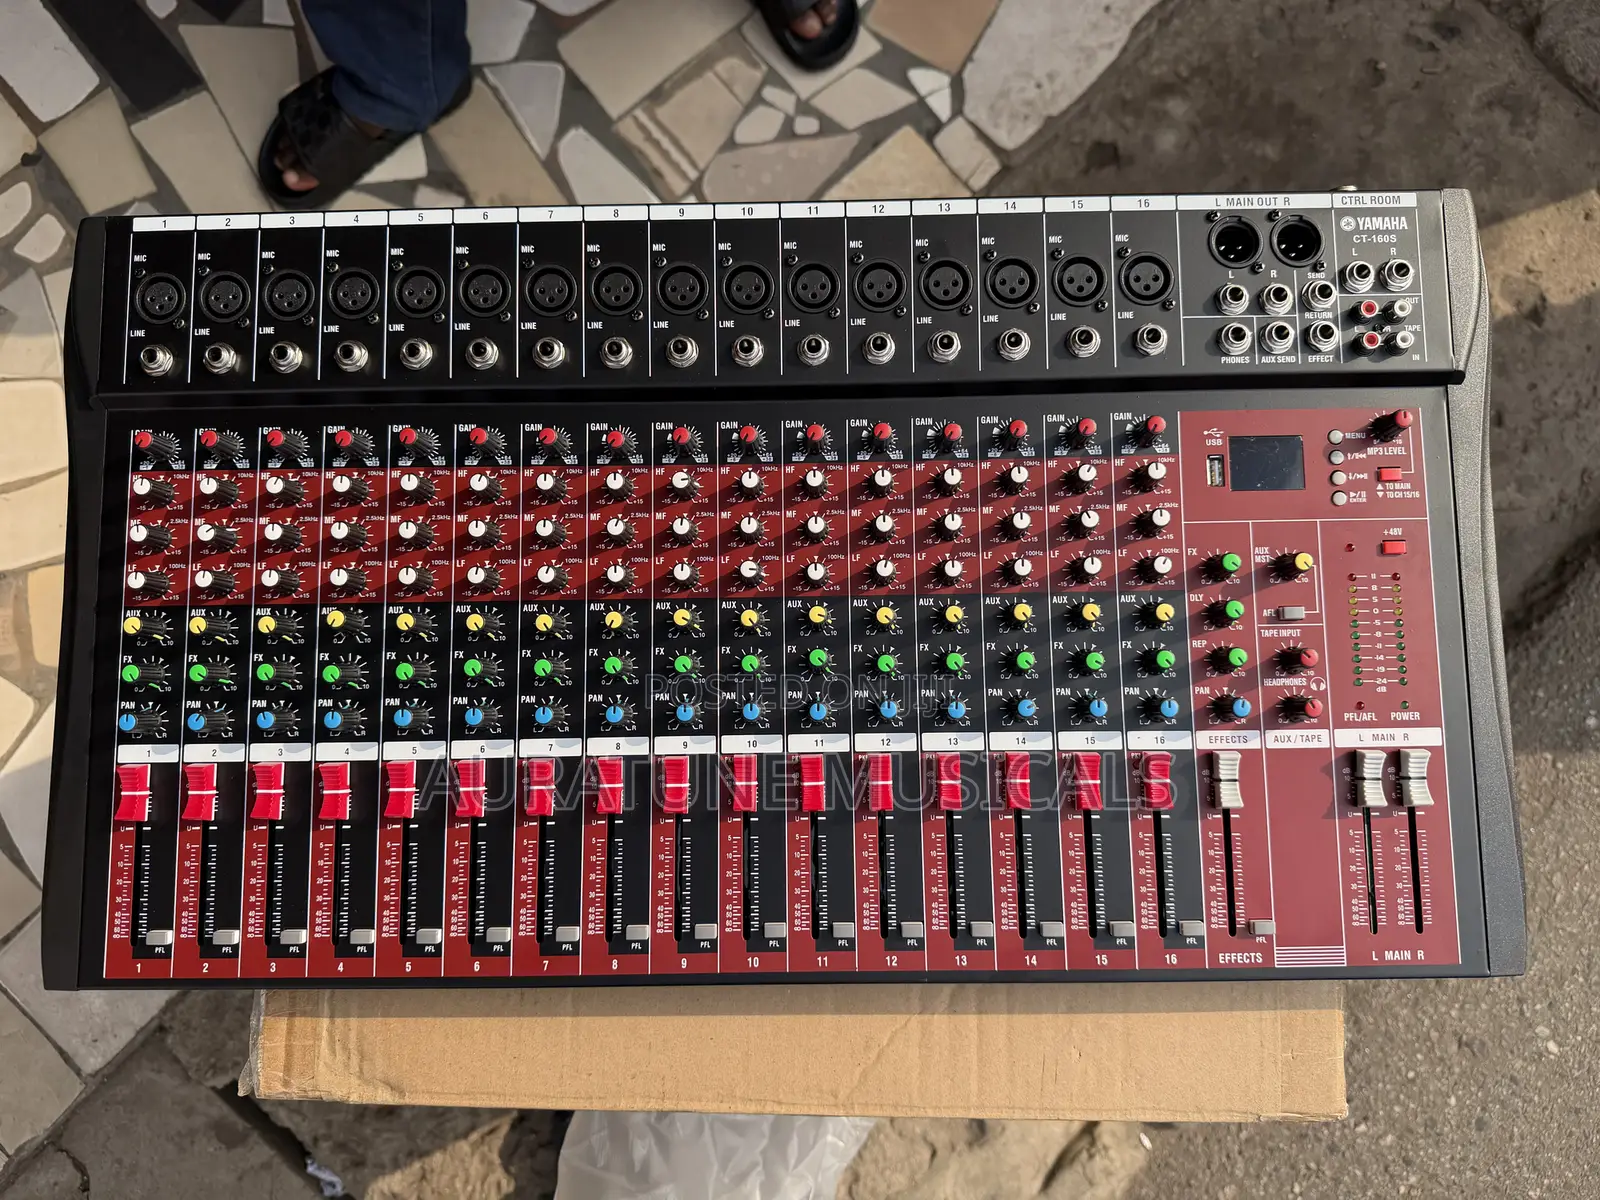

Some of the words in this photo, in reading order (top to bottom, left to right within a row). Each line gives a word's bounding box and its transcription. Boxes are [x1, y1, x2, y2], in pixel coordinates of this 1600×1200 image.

[1071, 200, 1084, 209] 15
[1138, 199, 1150, 208] 16
[1215, 198, 1221, 207] L
[1226, 197, 1254, 207] MAIN
[1257, 197, 1278, 206] OUT
[1283, 197, 1290, 206] R
[1341, 196, 1367, 205] CTRL
[1370, 195, 1401, 205] ROOM
[873, 204, 884, 213] 12
[939, 203, 951, 212] 13
[1004, 201, 1016, 210] 14
[548, 210, 554, 219] 7
[613, 209, 619, 218] 8
[679, 208, 684, 217] 9
[742, 207, 753, 216] 10
[808, 206, 818, 215] 11
[353, 215, 359, 223] 4
[418, 213, 424, 222] 5
[483, 211, 488, 220] 6
[162, 220, 166, 228] 1
[225, 218, 231, 227] 2
[289, 216, 295, 225] 3
[1357, 216, 1408, 230] YAMAHA
[1353, 234, 1397, 243] CT-160S
[521, 245, 534, 253] MIC
[1352, 248, 1358, 256] L
[1229, 270, 1234, 278] L
[1270, 270, 1277, 278] R
[981, 416, 998, 424] GAIN
[1114, 412, 1132, 420] GAIN
[785, 420, 803, 428] GAIN
[915, 417, 933, 426] GAIN
[1367, 447, 1383, 455] MP3
[1384, 447, 1407, 455] LEVEL
[456, 559, 465, 567] LF
[590, 558, 598, 566] LF
[1120, 595, 1136, 603] AUX
[1190, 594, 1204, 602] DLY
[1262, 609, 1275, 617] AFL
[1279, 629, 1301, 637] INPUT
[1264, 677, 1307, 686] HEADPHONES
[1344, 712, 1378, 722] PFL/AFL
[1391, 712, 1420, 721] POWER
[881, 738, 891, 746] 12
[948, 737, 958, 746] 13
[1085, 736, 1096, 745] 15
[1155, 736, 1165, 744] 16
[1209, 735, 1248, 744] EFFECTS
[1359, 734, 1364, 742] L
[1403, 733, 1409, 741] R
[616, 742, 621, 750] 8
[683, 741, 688, 749] 9
[747, 740, 757, 748] 10
[278, 748, 283, 756] 3
[412, 746, 417, 755] 5
[480, 745, 485, 753] 6
[1095, 954, 1108, 965] 15
[1165, 954, 1177, 964] 16
[1219, 952, 1263, 963] EFFECTS
[1372, 951, 1378, 961] L
[1385, 950, 1411, 960] MAIN
[1417, 950, 1424, 960] R
[612, 959, 618, 970] 8
[681, 958, 687, 969] 9
[747, 957, 759, 967] 10
[817, 956, 828, 967] 11
[886, 955, 897, 966] 12
[955, 955, 967, 966] 13
[1025, 955, 1037, 966] 14
[136, 963, 141, 973] 1
[203, 963, 209, 973] 2
[270, 962, 276, 972] 3
[337, 962, 343, 972] 4
[406, 962, 411, 972] 5
[474, 961, 480, 972] 6
[543, 960, 549, 971] 7
